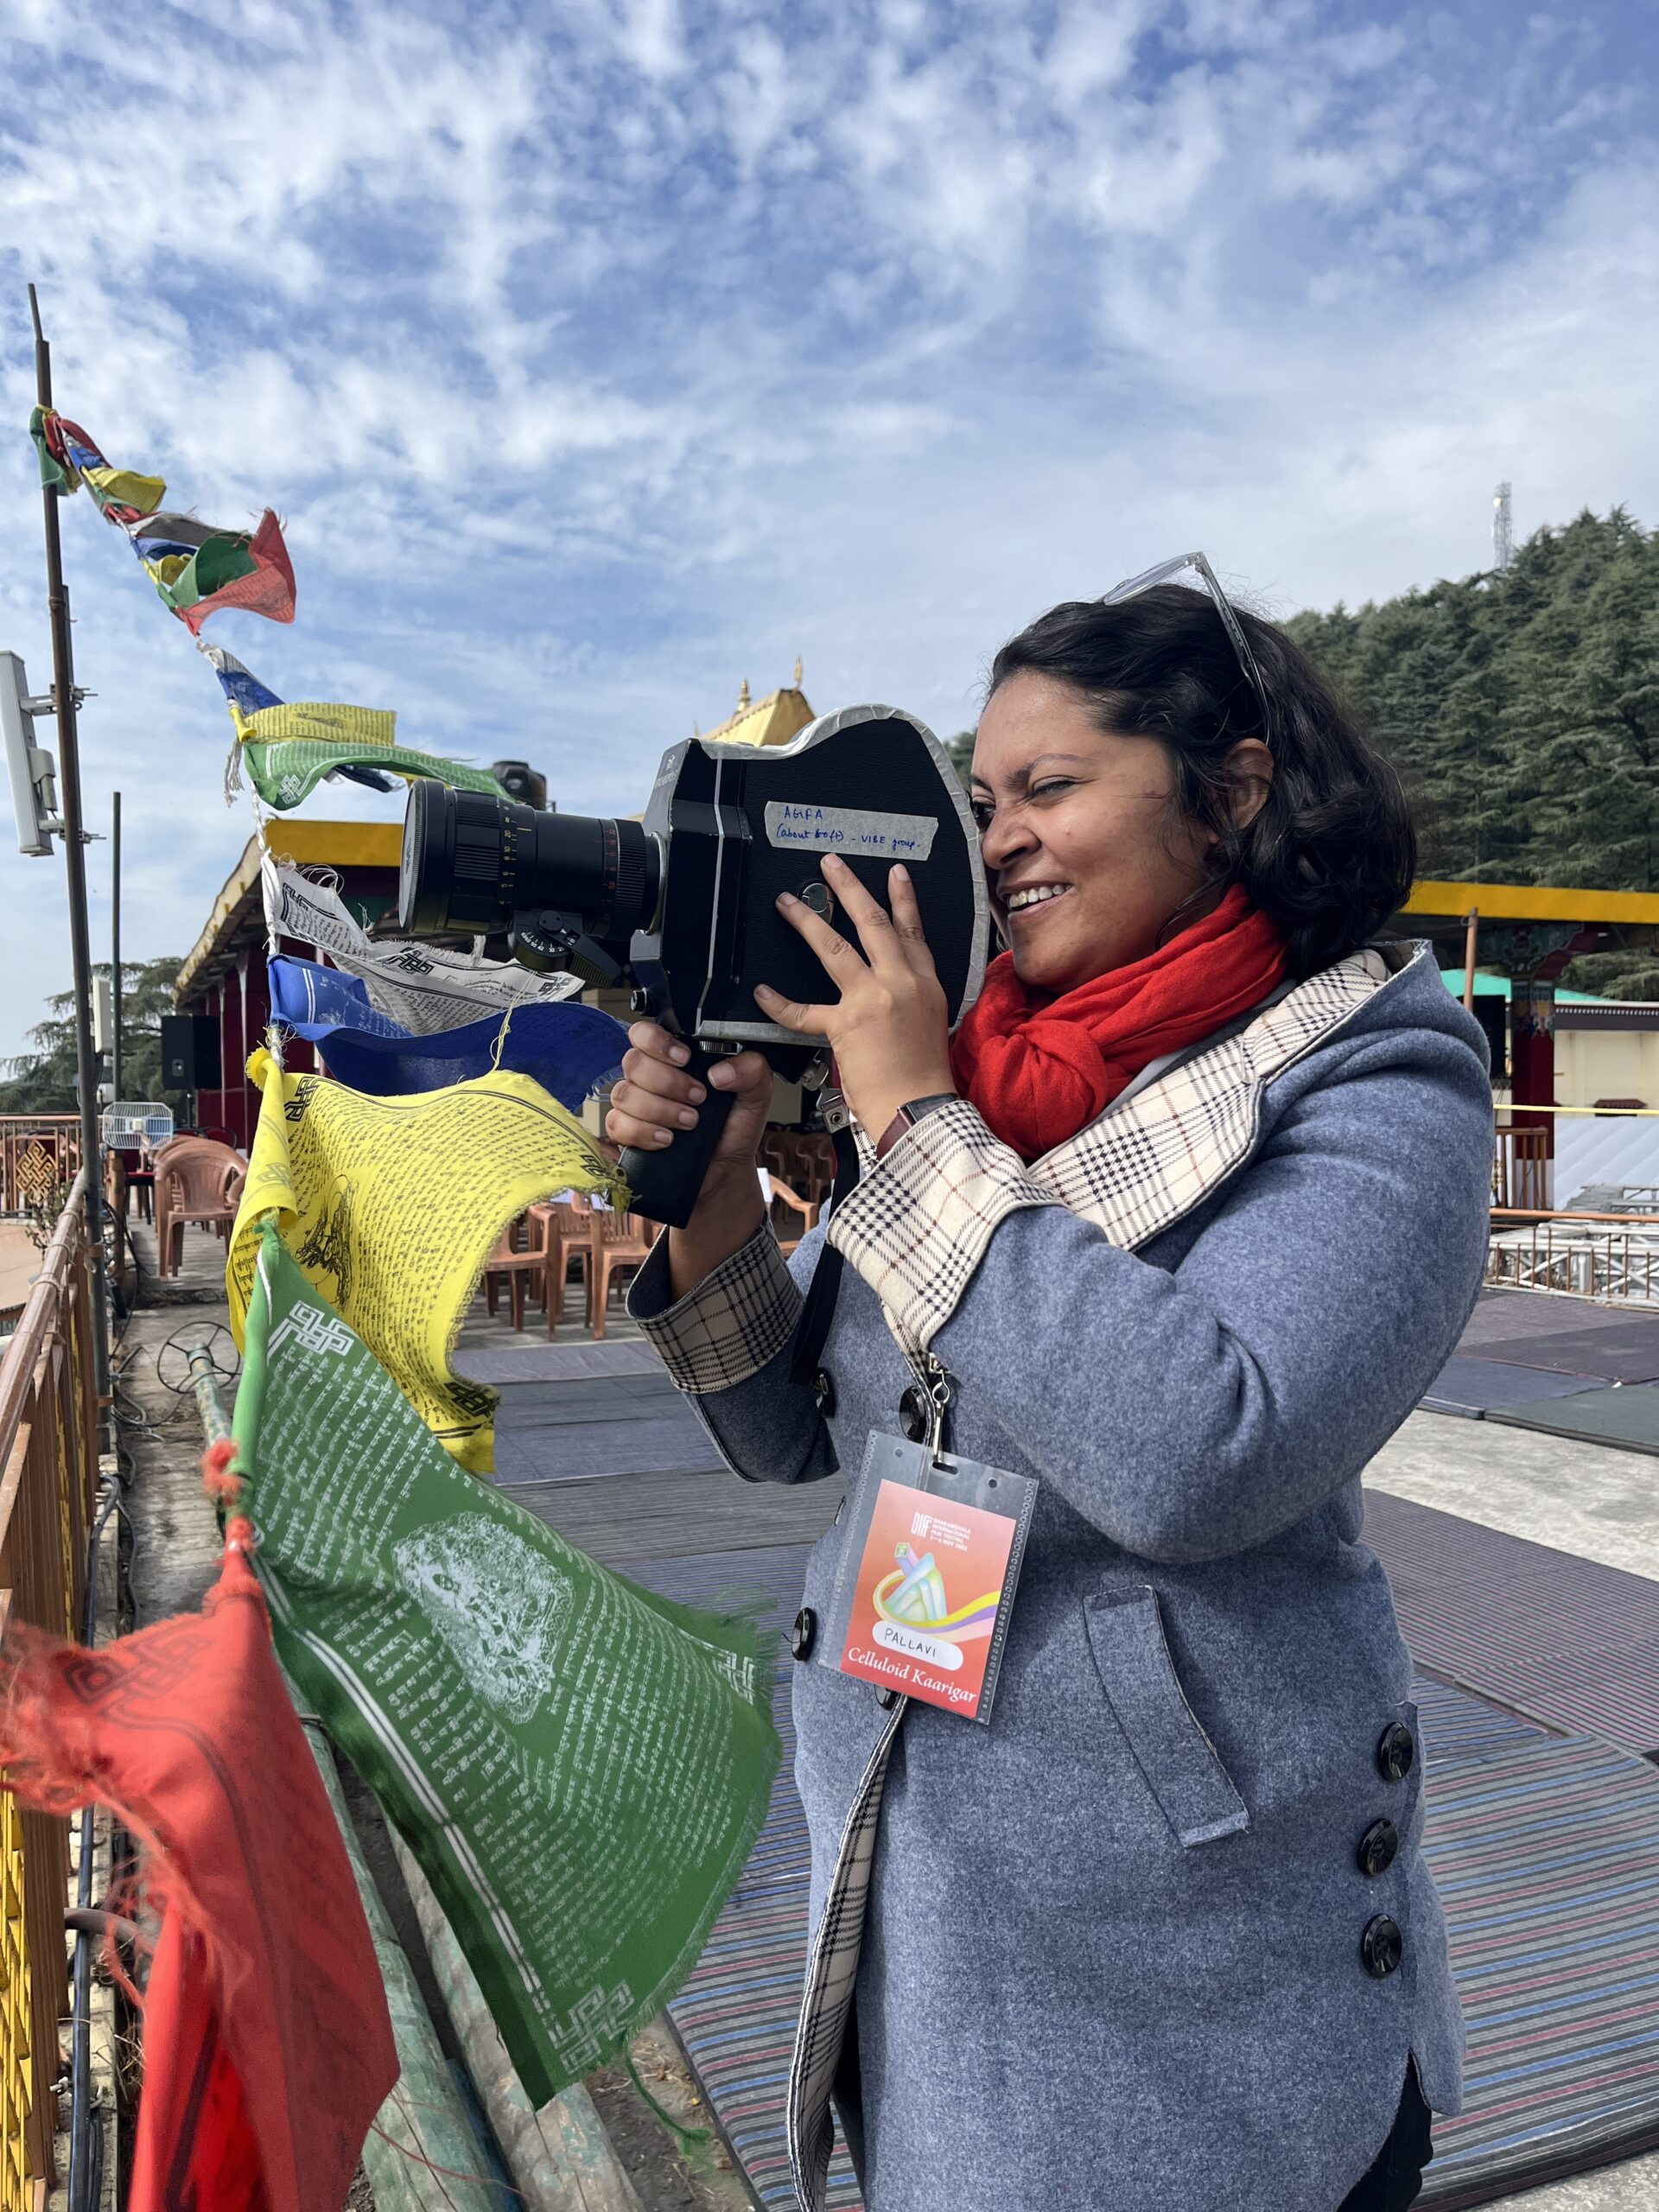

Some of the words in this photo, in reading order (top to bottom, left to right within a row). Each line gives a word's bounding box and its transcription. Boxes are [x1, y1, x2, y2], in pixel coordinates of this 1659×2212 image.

[784, 805, 823, 820] AGFA
[504, 830, 512, 838] 20
[776, 823, 811, 839] (about
[861, 835, 886, 844] VIBE
[884, 1627, 937, 1657] PALLAVI
[848, 1647, 910, 1679] Celluloid
[911, 1669, 977, 1703] Kaarigar
